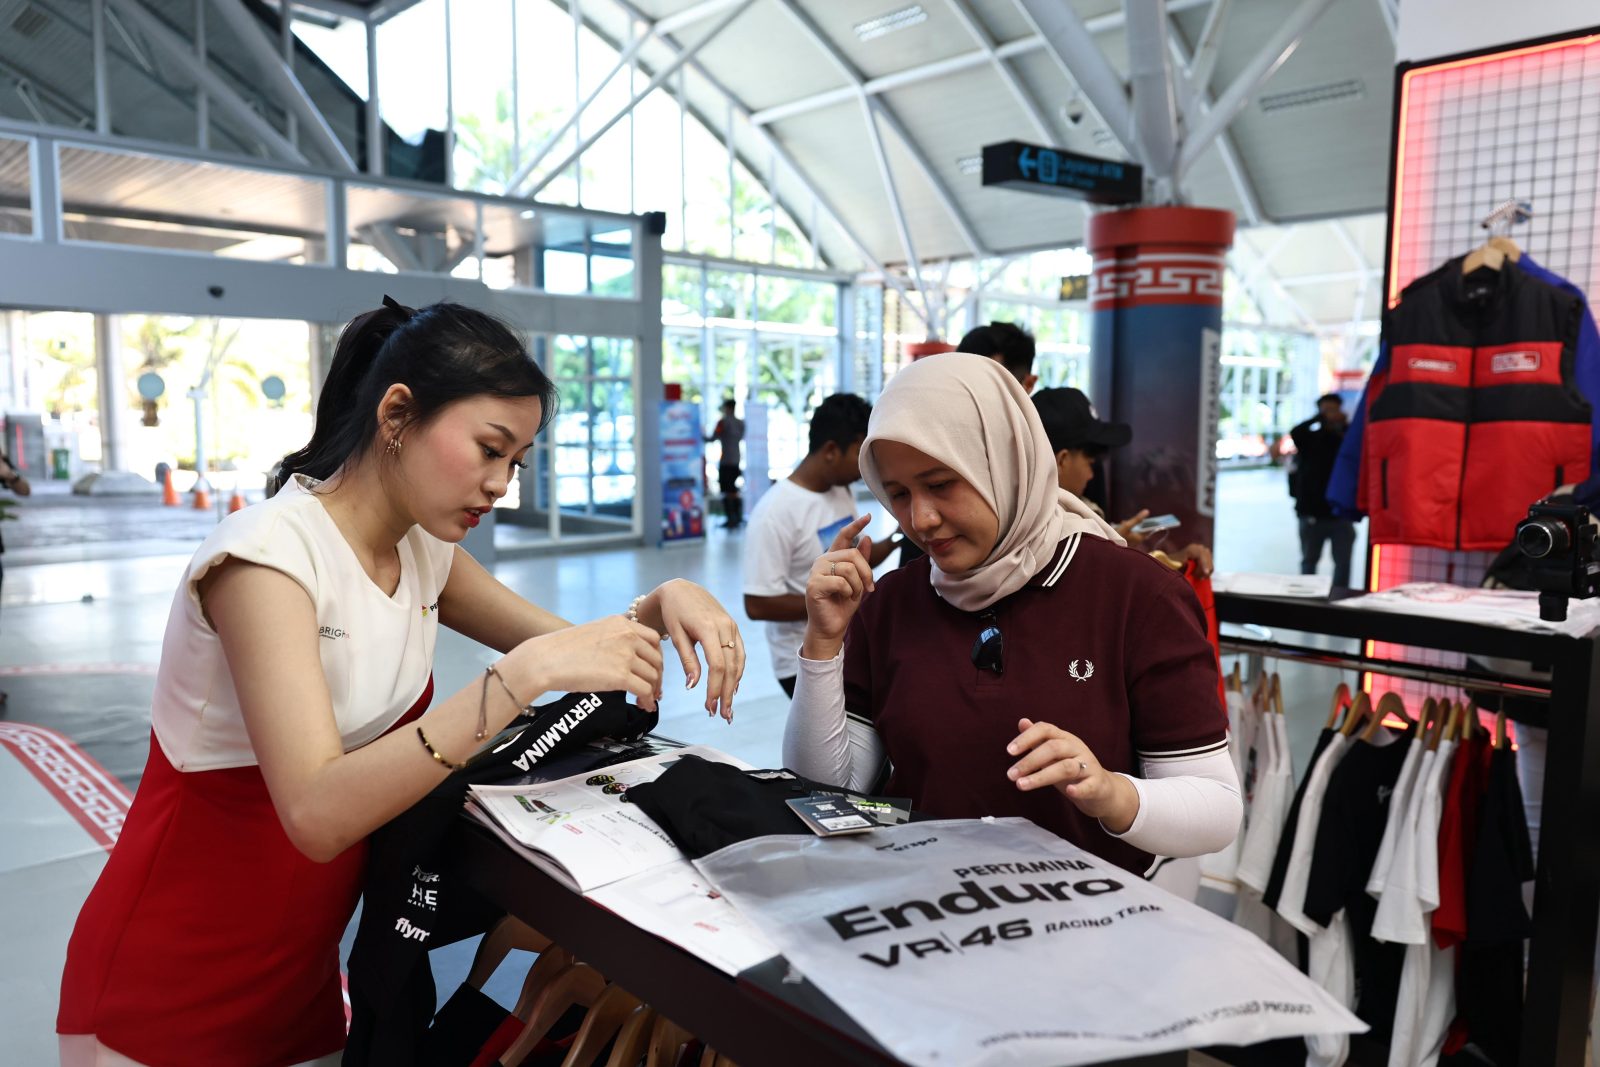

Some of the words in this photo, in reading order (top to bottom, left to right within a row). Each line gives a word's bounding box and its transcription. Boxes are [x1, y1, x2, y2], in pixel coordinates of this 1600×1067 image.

[512, 693, 603, 771] PERTAMINA
[953, 859, 1094, 879] PERTAMINA
[824, 877, 1125, 941] Enduro
[1045, 917, 1113, 934] RACING
[1116, 904, 1163, 920] TEAM
